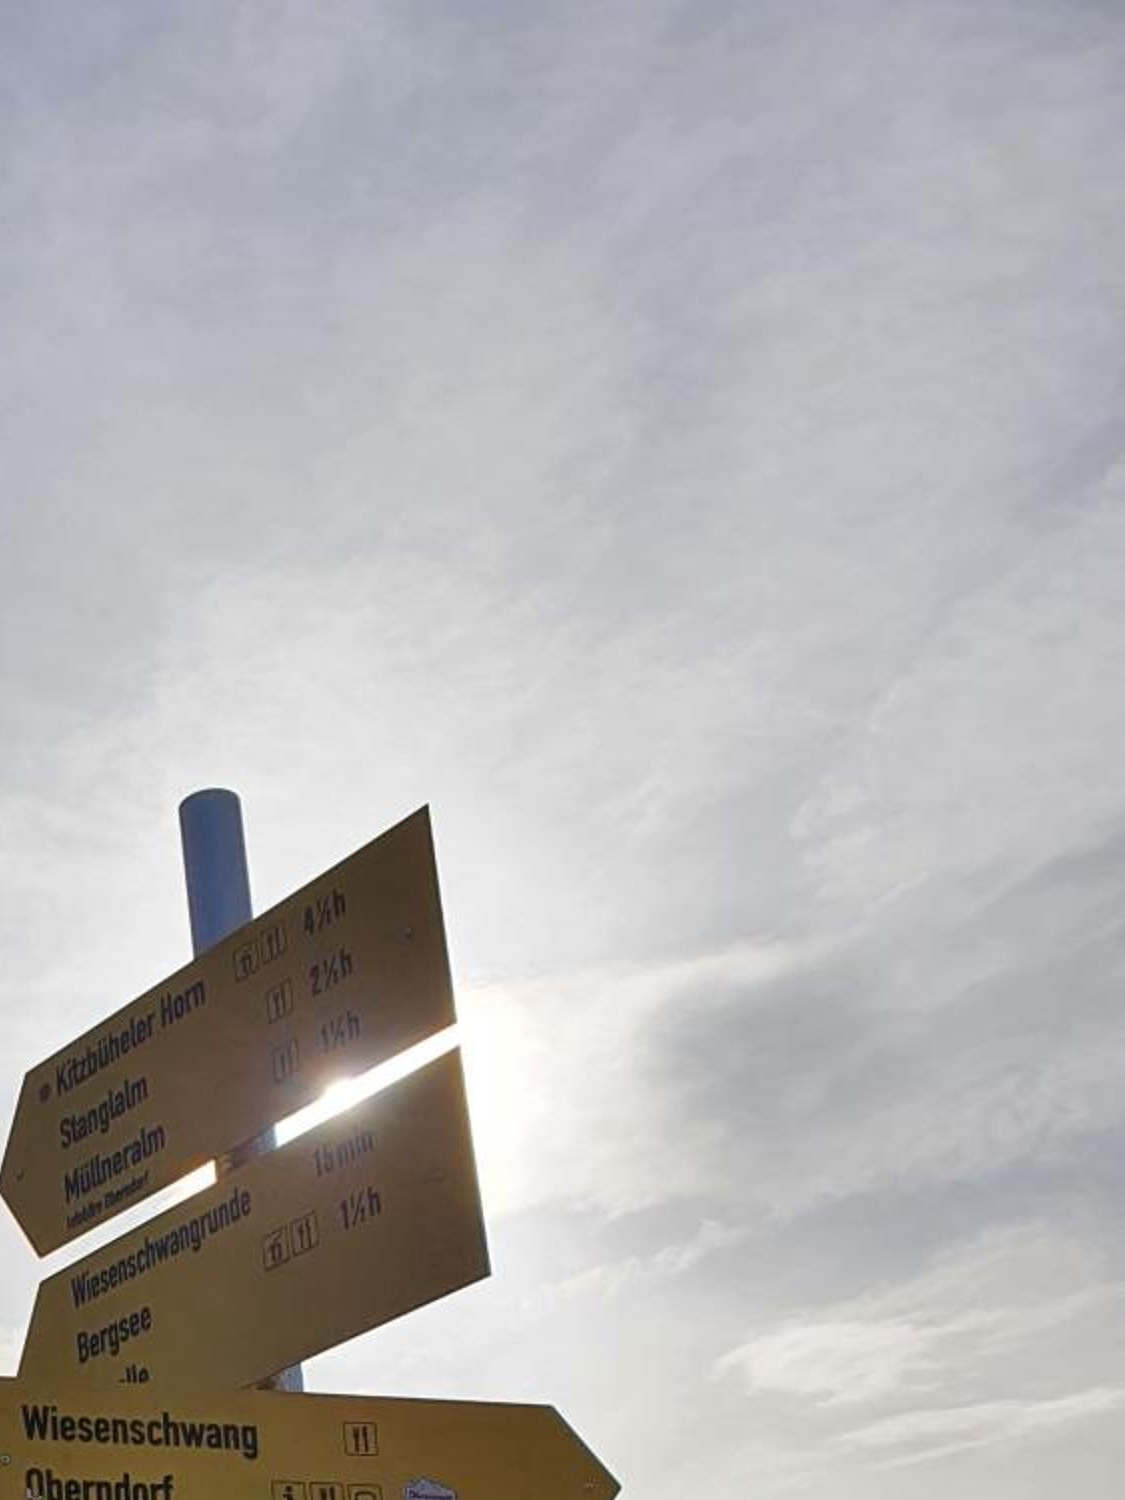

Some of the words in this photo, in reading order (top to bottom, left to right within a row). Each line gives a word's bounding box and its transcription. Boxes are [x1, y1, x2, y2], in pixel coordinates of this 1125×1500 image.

[55, 1012, 156, 1097] Kitzbüheler
[160, 980, 206, 1029] Horn
[59, 1076, 149, 1149] Stanglalm
[63, 1125, 166, 1202] Müllneralm
[71, 1187, 252, 1307] Wiesenschwangrunde
[77, 1306, 152, 1364] Bergsee
[21, 1405, 258, 1460] Wiesenschwang
